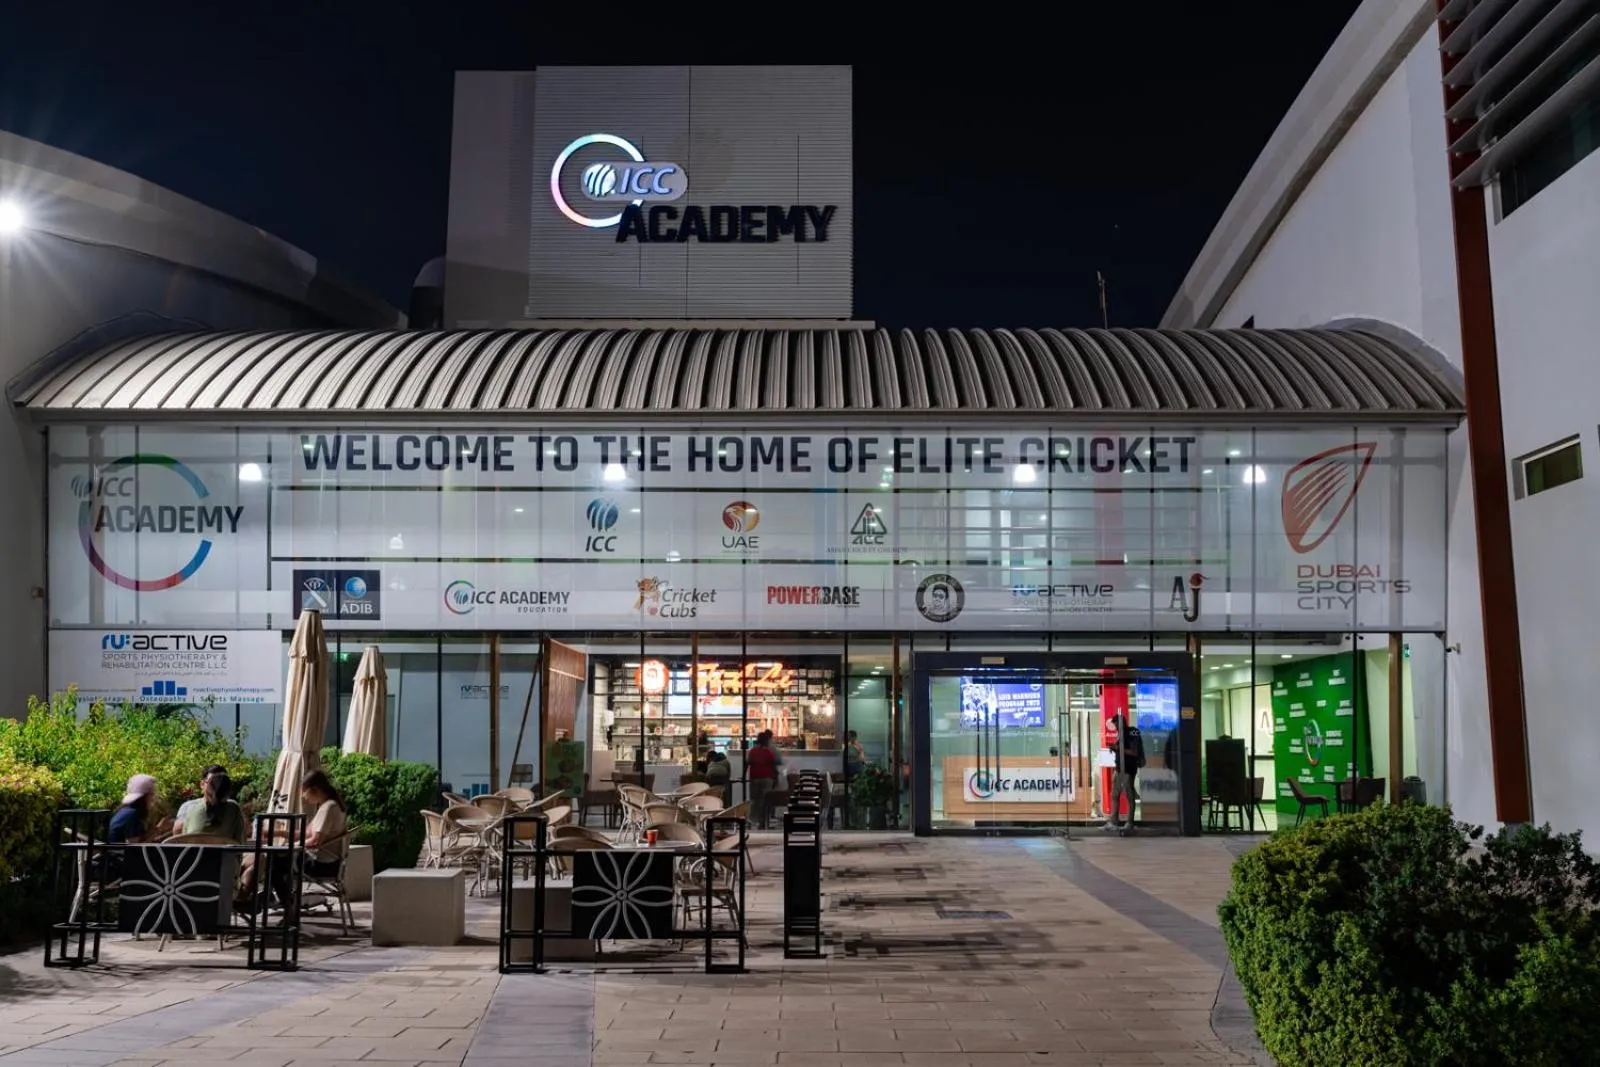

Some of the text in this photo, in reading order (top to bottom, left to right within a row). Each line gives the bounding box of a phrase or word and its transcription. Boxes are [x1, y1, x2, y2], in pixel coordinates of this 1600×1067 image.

[620, 168, 676, 194] ICC
[615, 204, 838, 243] ACADEMY
[302, 434, 1197, 473] WELCOME TO THE HOME OF ELITE CRICKET
[97, 477, 134, 497] ICC
[95, 505, 244, 533] ACADEMY
[585, 535, 618, 552] ICC
[722, 535, 760, 549] UAE
[1297, 564, 1381, 578] DUBAI
[1297, 580, 1411, 594] SPORTS
[470, 591, 571, 605] ICC ACADEMY
[662, 587, 717, 603] Cricket
[340, 603, 373, 614] ADIB
[1297, 596, 1356, 610] CITY
[660, 603, 697, 618] Cubs
[102, 653, 139, 661] SPORTS
[141, 653, 218, 661] PHYSIOTHERAPY
[102, 661, 170, 669] REHABILITATION
[172, 661, 207, 669] CENTRE
